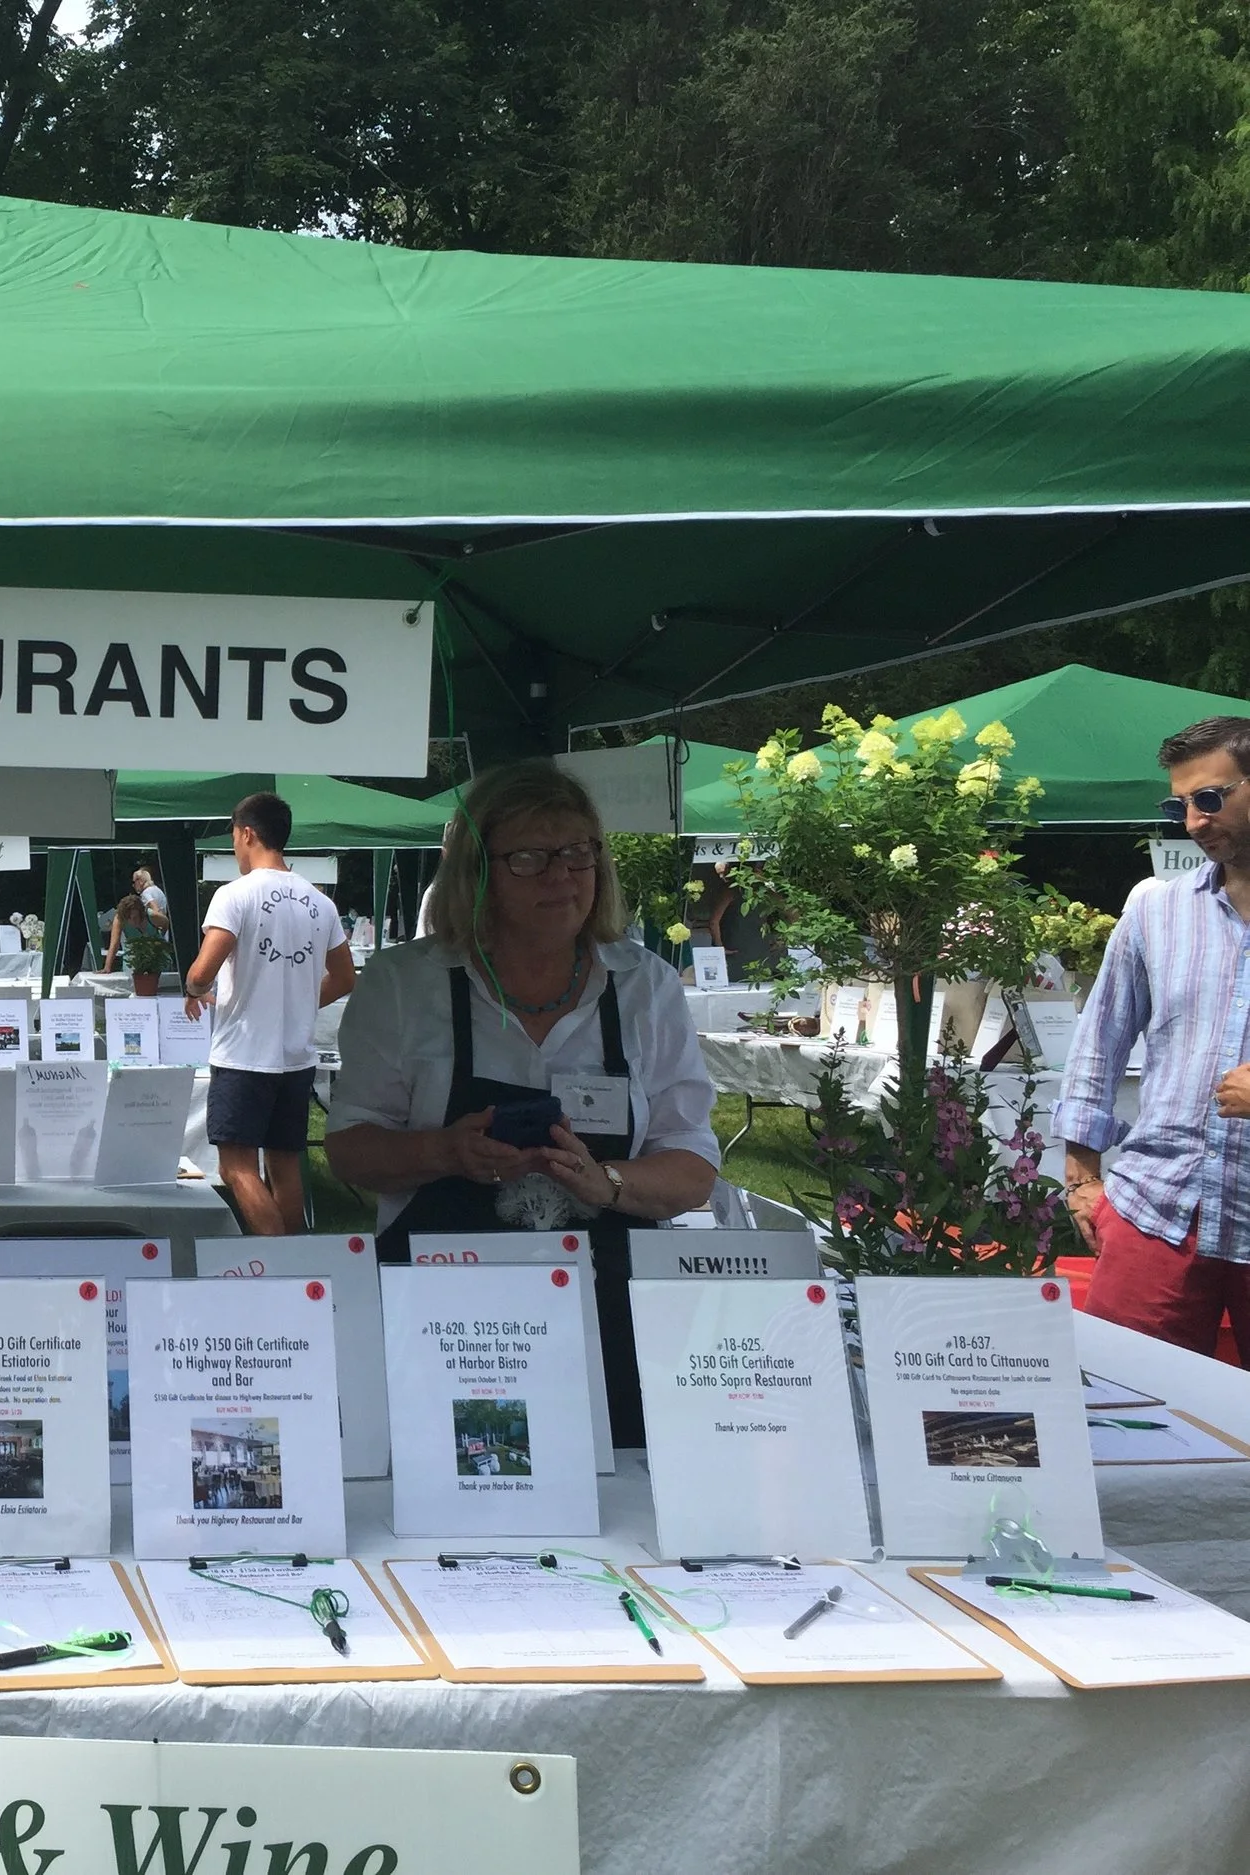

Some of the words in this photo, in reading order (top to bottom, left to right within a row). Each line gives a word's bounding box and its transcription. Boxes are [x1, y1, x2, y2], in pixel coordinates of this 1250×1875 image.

[678, 1256, 768, 1274] NEW!!!!!
[474, 1320, 500, 1336] $125
[502, 1322, 520, 1336] Gift
[524, 1322, 548, 1336] Card
[8, 1336, 26, 1350] Gift
[30, 1336, 80, 1350] Certificate
[204, 1336, 232, 1352] $150
[234, 1336, 254, 1352] Gift
[256, 1336, 310, 1352] Certificate
[440, 1338, 454, 1352] for
[458, 1338, 492, 1352] Dinner
[496, 1338, 510, 1352] for
[512, 1340, 530, 1352] two
[2, 1354, 50, 1368] Estiatorio
[172, 1358, 182, 1370] to
[186, 1354, 232, 1374] Highway
[234, 1354, 292, 1368] Restaurant
[446, 1358, 456, 1370] at
[458, 1356, 494, 1370] Harbor
[498, 1356, 528, 1370] Bistro
[690, 1354, 716, 1370] $150
[720, 1354, 738, 1368] Gift
[742, 1354, 794, 1370] Certificate
[894, 1350, 922, 1368] $100
[926, 1352, 944, 1366] Gift
[948, 1352, 974, 1366] Card
[976, 1356, 988, 1368] to
[990, 1354, 1050, 1368] Cittanuova
[212, 1372, 232, 1386] and
[236, 1372, 254, 1386] Bar
[676, 1374, 688, 1386] to
[690, 1372, 718, 1386] Sotto
[720, 1372, 752, 1390] Sopra
[754, 1372, 812, 1386] Restaurant
[714, 1422, 734, 1432] Thank
[736, 1426, 748, 1434] you
[750, 1422, 766, 1432] Sotto
[768, 1422, 786, 1434] Sopra
[950, 1472, 972, 1482] Thank
[972, 1474, 986, 1484] you
[986, 1472, 1022, 1482] Cittanuova
[458, 1480, 478, 1490] Thank
[478, 1484, 490, 1492] you
[492, 1480, 514, 1490] Harbor
[516, 1482, 534, 1490] Bistro
[0, 1504, 16, 1514] Elaia
[18, 1504, 48, 1514] Estiatorio
[176, 1514, 196, 1524] Thank
[196, 1518, 210, 1526] you
[210, 1514, 240, 1526] Highway
[240, 1514, 276, 1524] Restaurant
[276, 1514, 290, 1524] and
[292, 1514, 302, 1524] Bar
